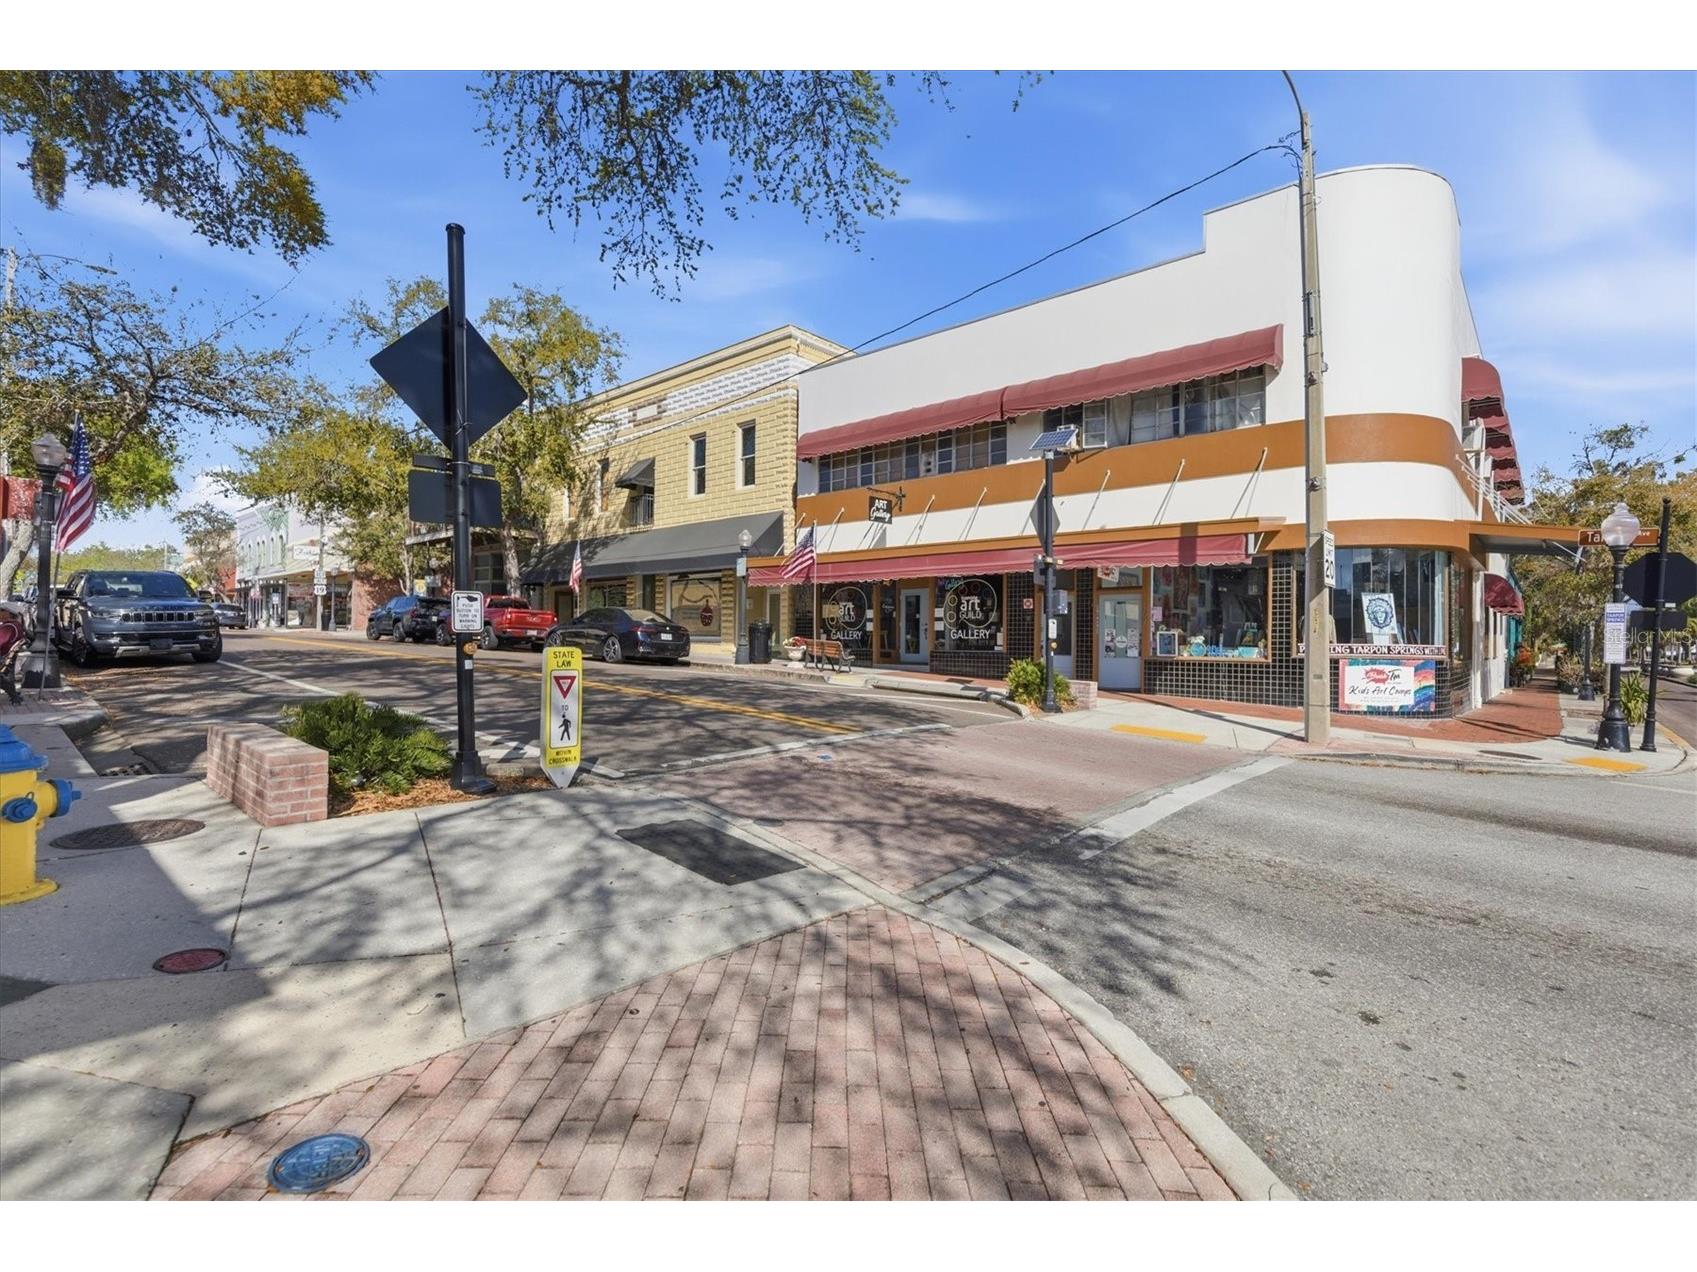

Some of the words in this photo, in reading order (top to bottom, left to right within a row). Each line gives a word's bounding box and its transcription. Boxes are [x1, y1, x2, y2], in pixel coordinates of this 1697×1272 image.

[960, 598, 980, 611] art
[831, 630, 862, 640] GALLERY
[950, 629, 991, 640] GALLERY
[553, 651, 575, 659] STATE
[1352, 645, 1388, 655] TARPON
[1389, 646, 1424, 656] SPRINGS
[556, 660, 572, 668] LAW
[1349, 685, 1370, 695] Kids
